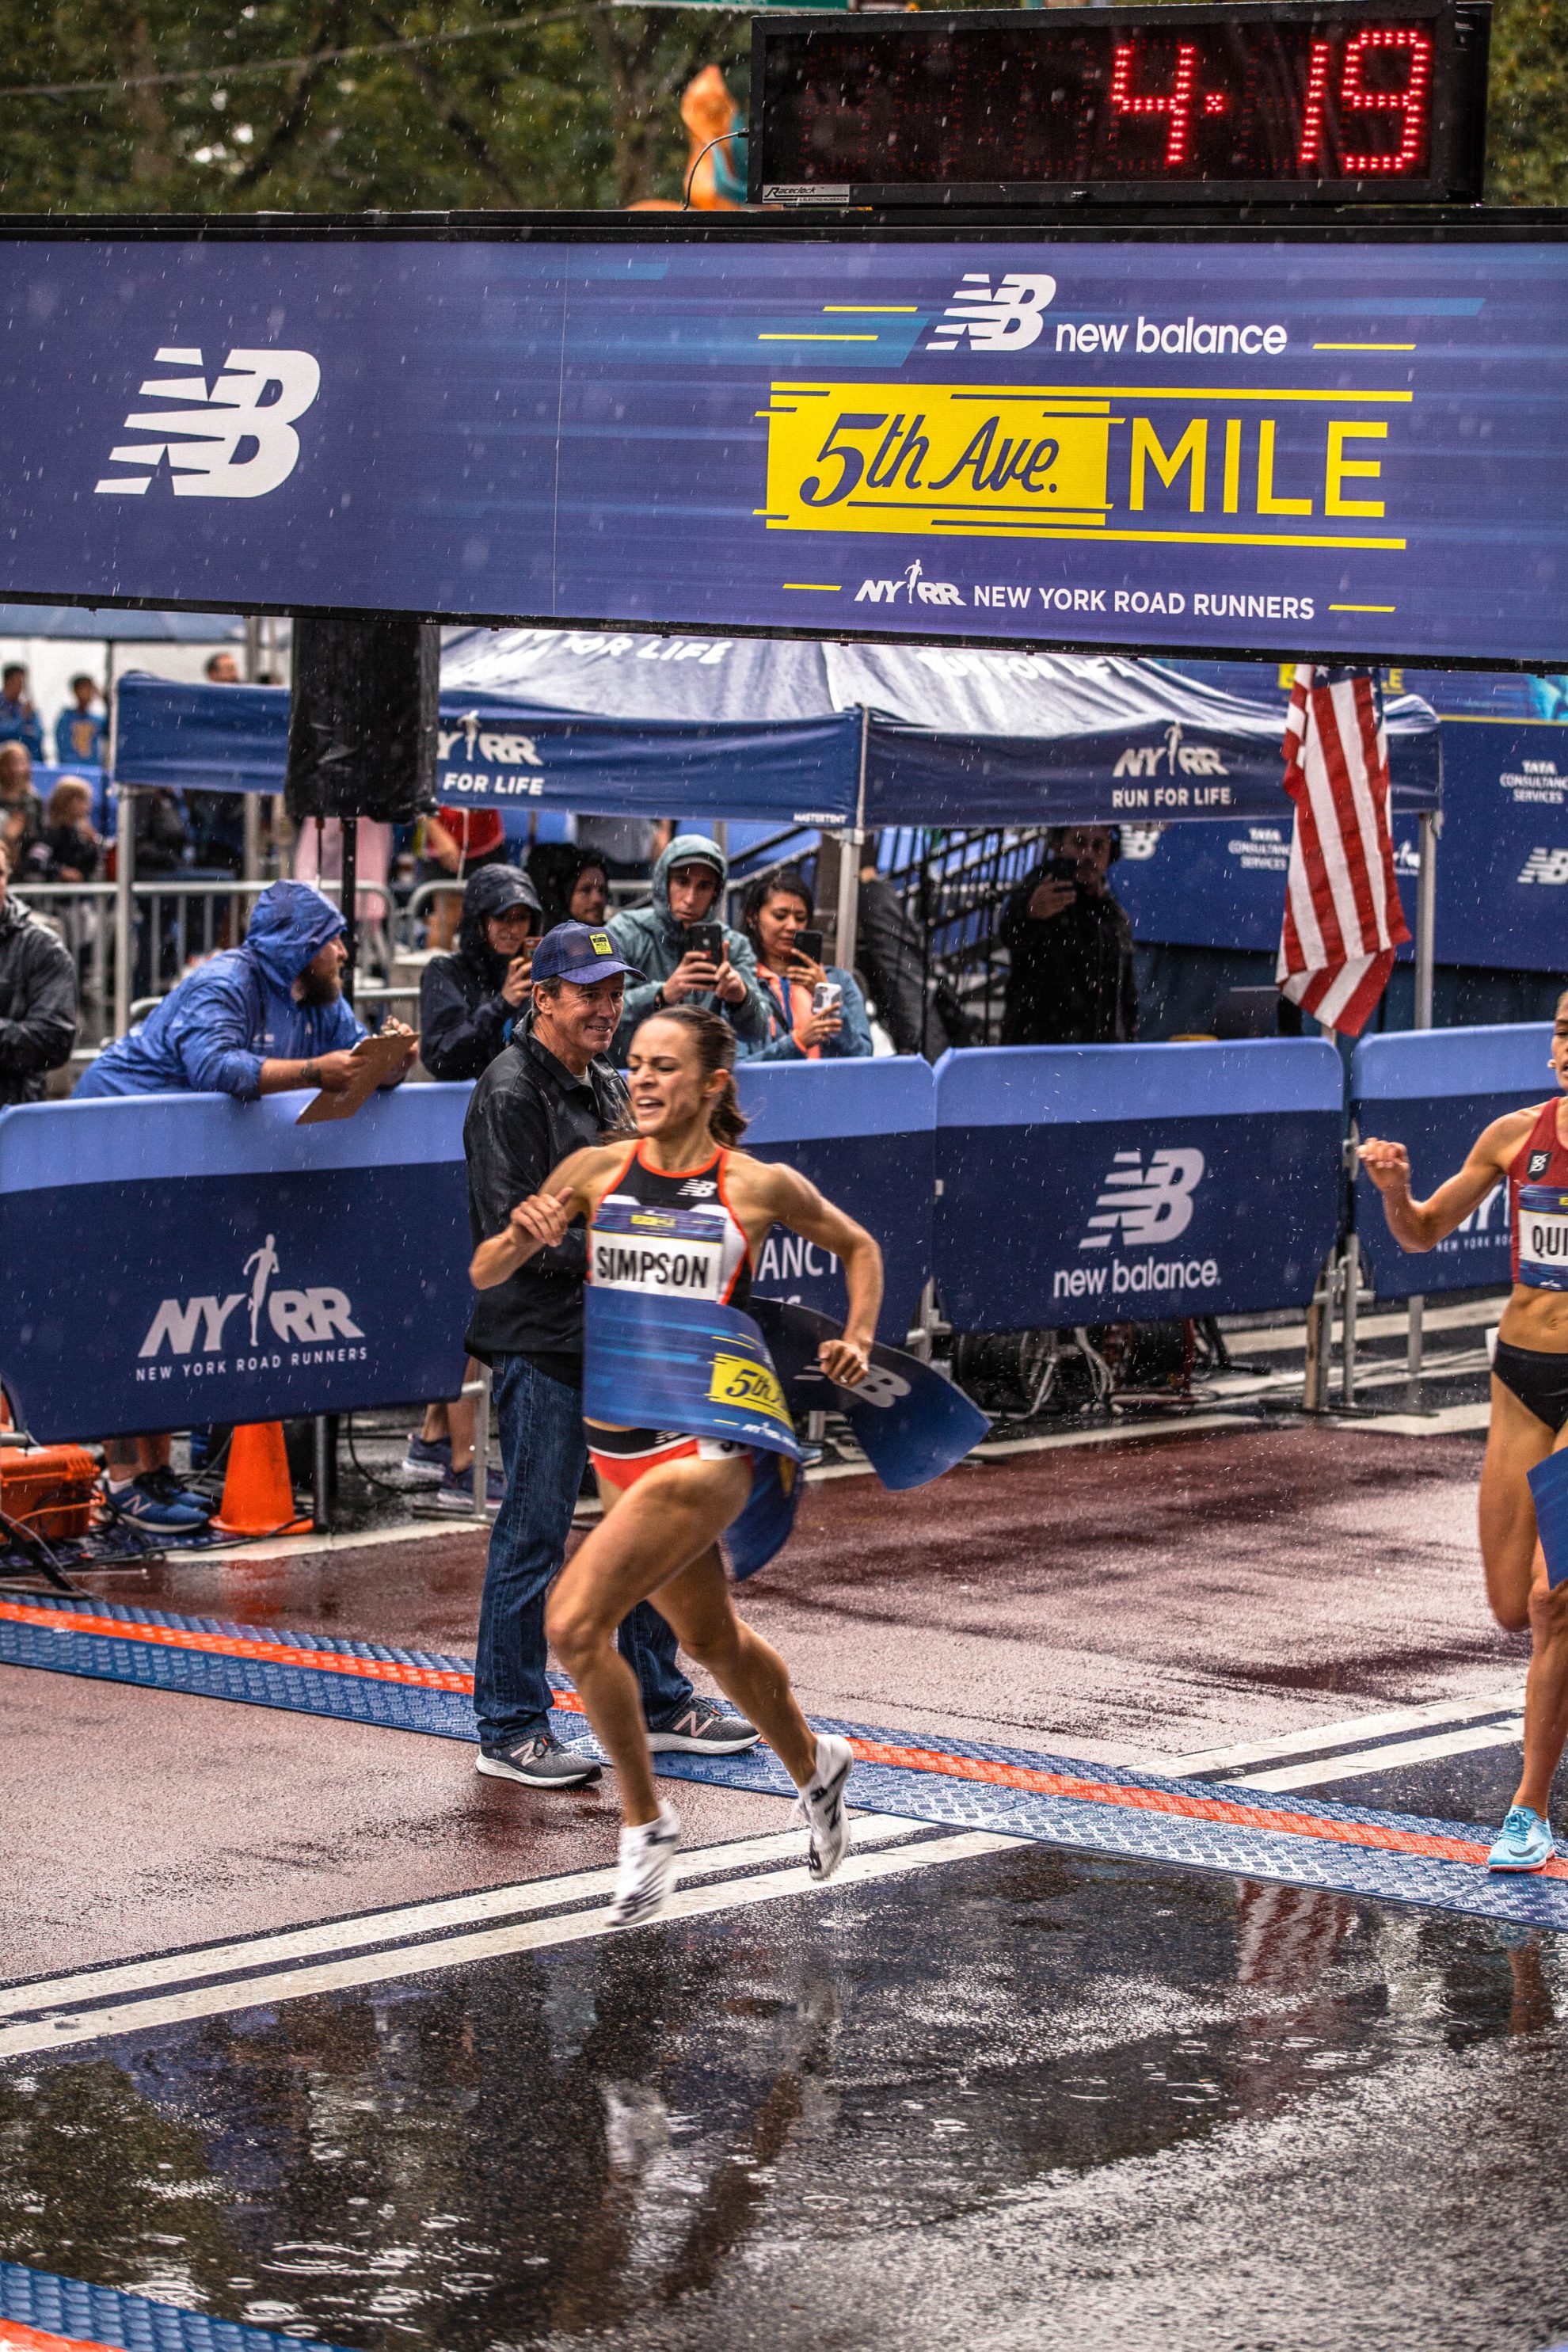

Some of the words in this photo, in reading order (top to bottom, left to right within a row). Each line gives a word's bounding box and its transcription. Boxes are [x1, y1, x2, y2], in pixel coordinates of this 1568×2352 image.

[1055, 322, 1128, 353] new
[1136, 316, 1288, 355] balance
[799, 413, 929, 507] 5th
[927, 416, 1059, 493] Ave.
[1129, 418, 1388, 518] MILE
[973, 585, 1033, 609] NEW
[1039, 587, 1106, 612] YORK
[1113, 590, 1186, 615] ROAD
[1194, 592, 1315, 620] RUNNERS
[636, 640, 733, 664] LIFE
[436, 732, 544, 766] YRR
[1499, 772, 1568, 790] CONSULTANC
[1522, 759, 1558, 775] TATA
[443, 772, 489, 793] FOR
[494, 775, 545, 796] LIFE
[1112, 789, 1148, 808] RUN
[1154, 787, 1189, 807] FOR
[1193, 787, 1231, 806] LIFE
[1513, 788, 1565, 805] SERVICES
[1436, 1239, 1459, 1253] NEW
[1464, 1236, 1490, 1250] YORK
[596, 1246, 709, 1288] SIMPSON
[1054, 1265, 1107, 1298] new
[1112, 1259, 1218, 1295] balance
[136, 1366, 173, 1382] NEW
[183, 1361, 226, 1379] YORK
[236, 1355, 282, 1373] ROAD
[291, 1346, 368, 1366] RUNNERS
